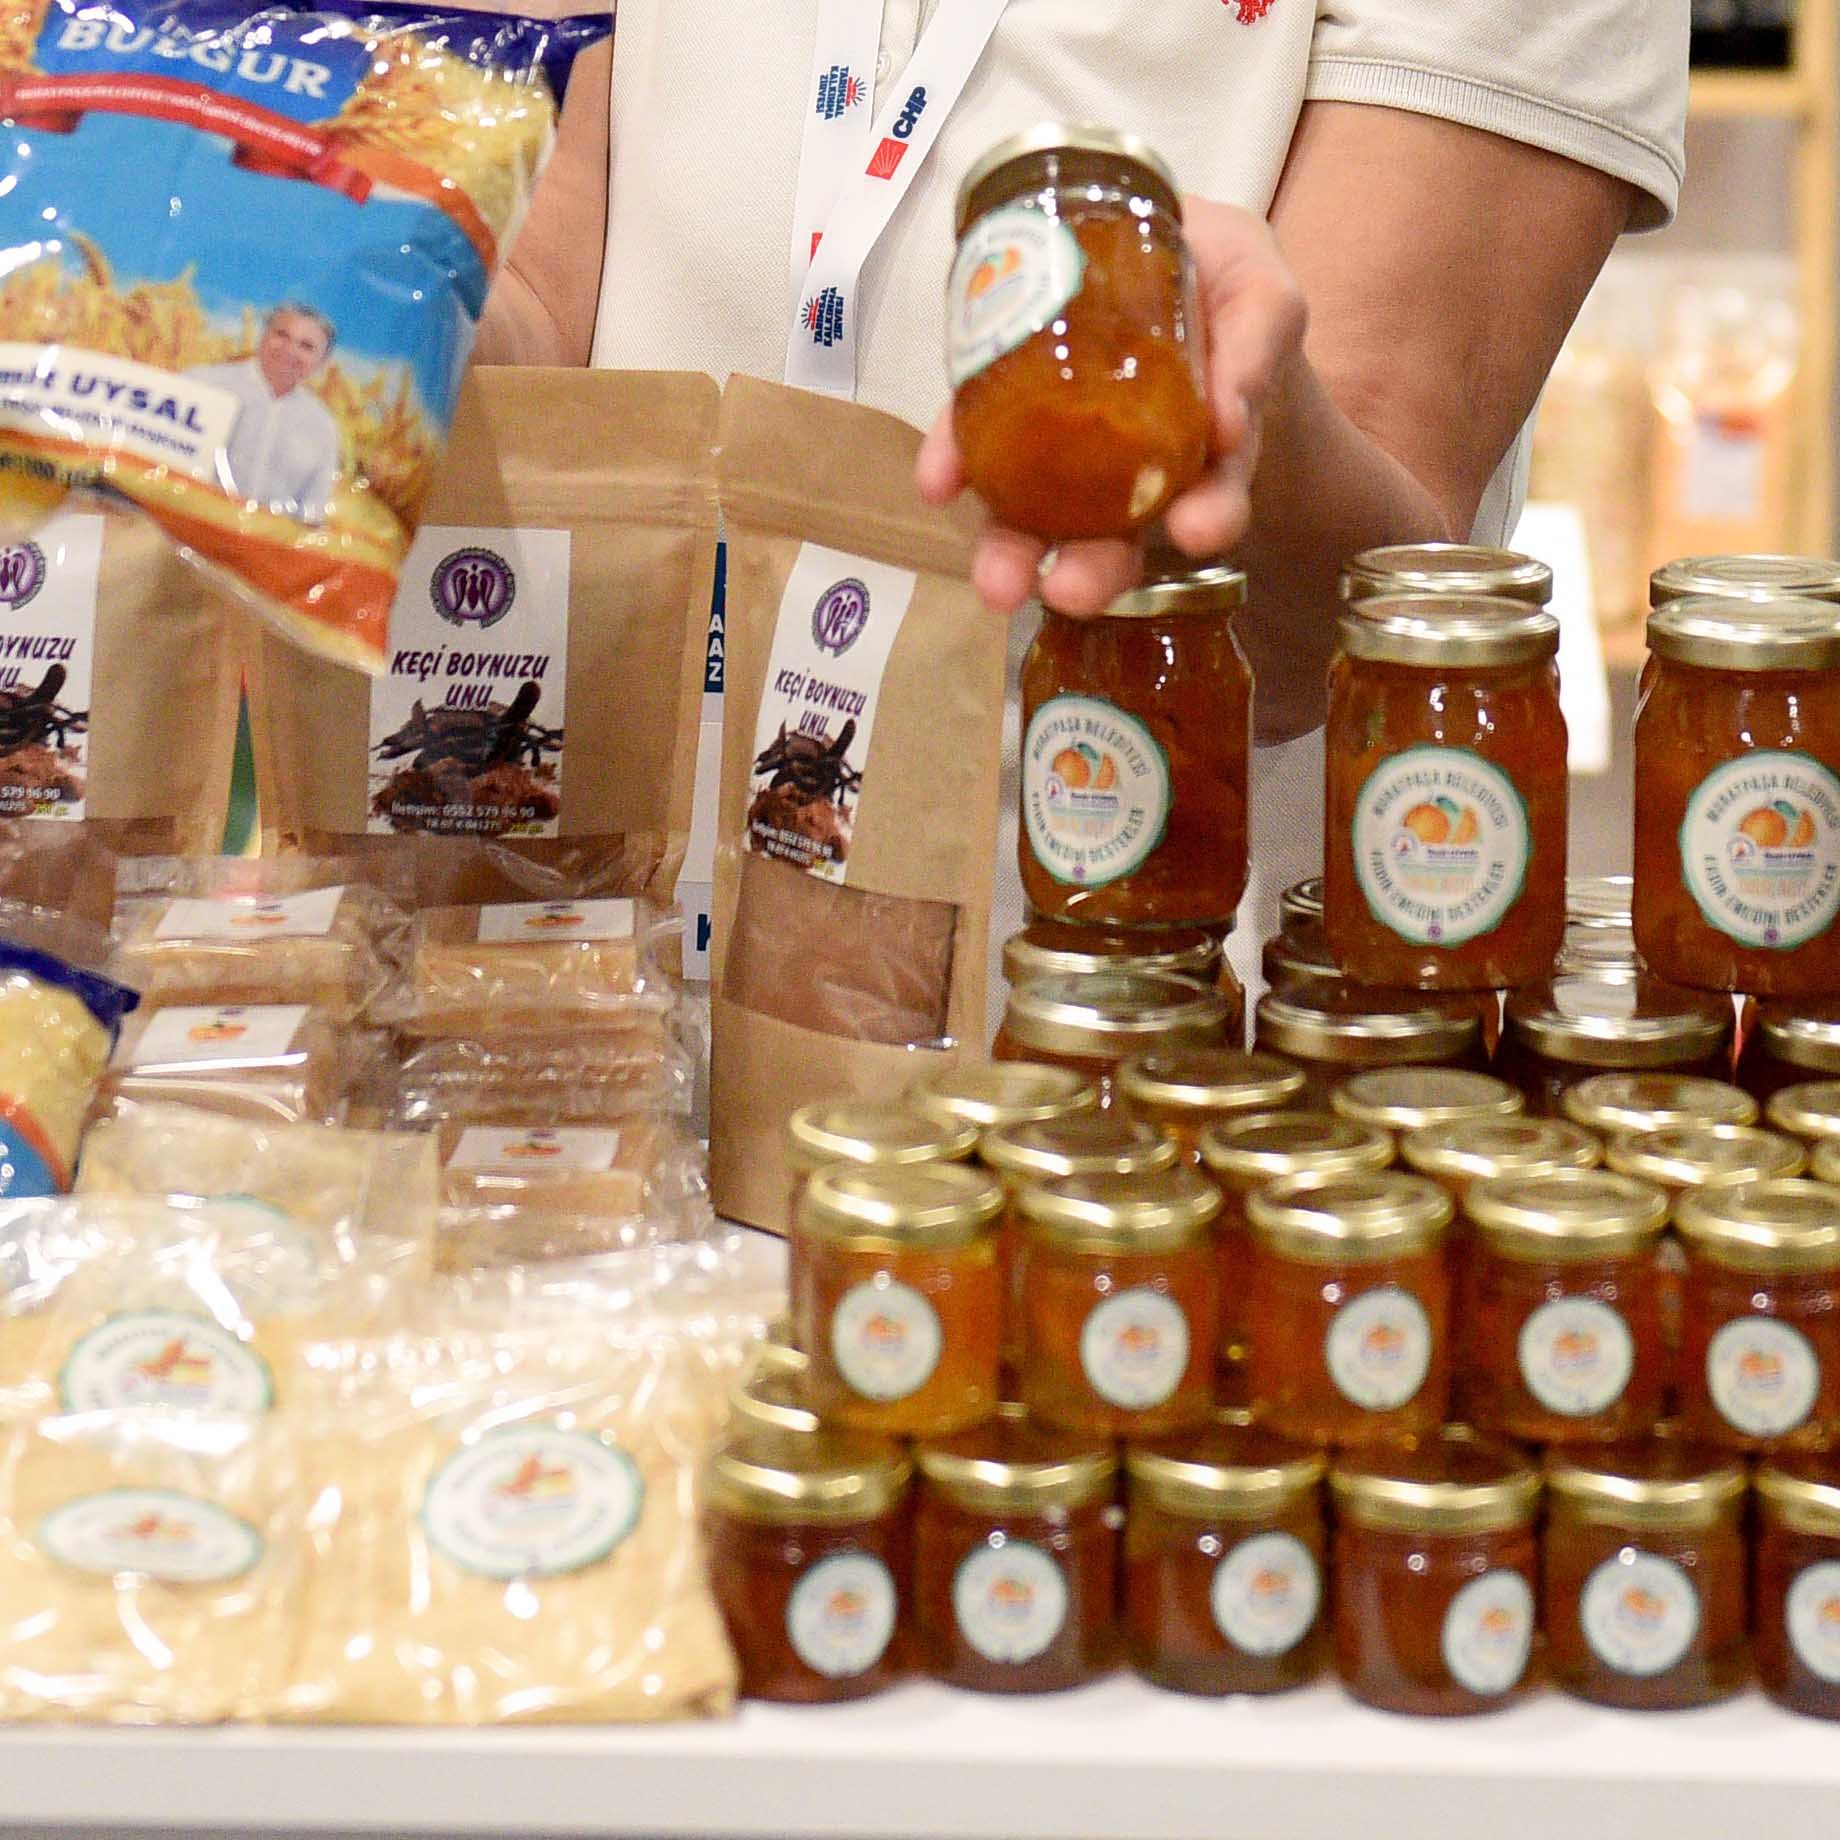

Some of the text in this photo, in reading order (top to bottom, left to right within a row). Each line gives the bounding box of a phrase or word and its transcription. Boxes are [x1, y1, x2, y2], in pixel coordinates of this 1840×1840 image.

[57, 18, 333, 100] BULGUR
[824, 66, 839, 120] KALKINMA
[835, 66, 849, 118] TARIMSAL
[892, 86, 927, 138] CHP
[814, 287, 829, 344] TARIMSAL
[823, 287, 837, 347] KALKINMA
[71, 374, 205, 434] UYSAL
[390, 644, 550, 682] KEÇİ BOYNUZU
[446, 683, 494, 708] UNU
[774, 667, 867, 716] KEÇİ BOYNUZU
[799, 710, 829, 737] UNU
[476, 805, 498, 817] 579
